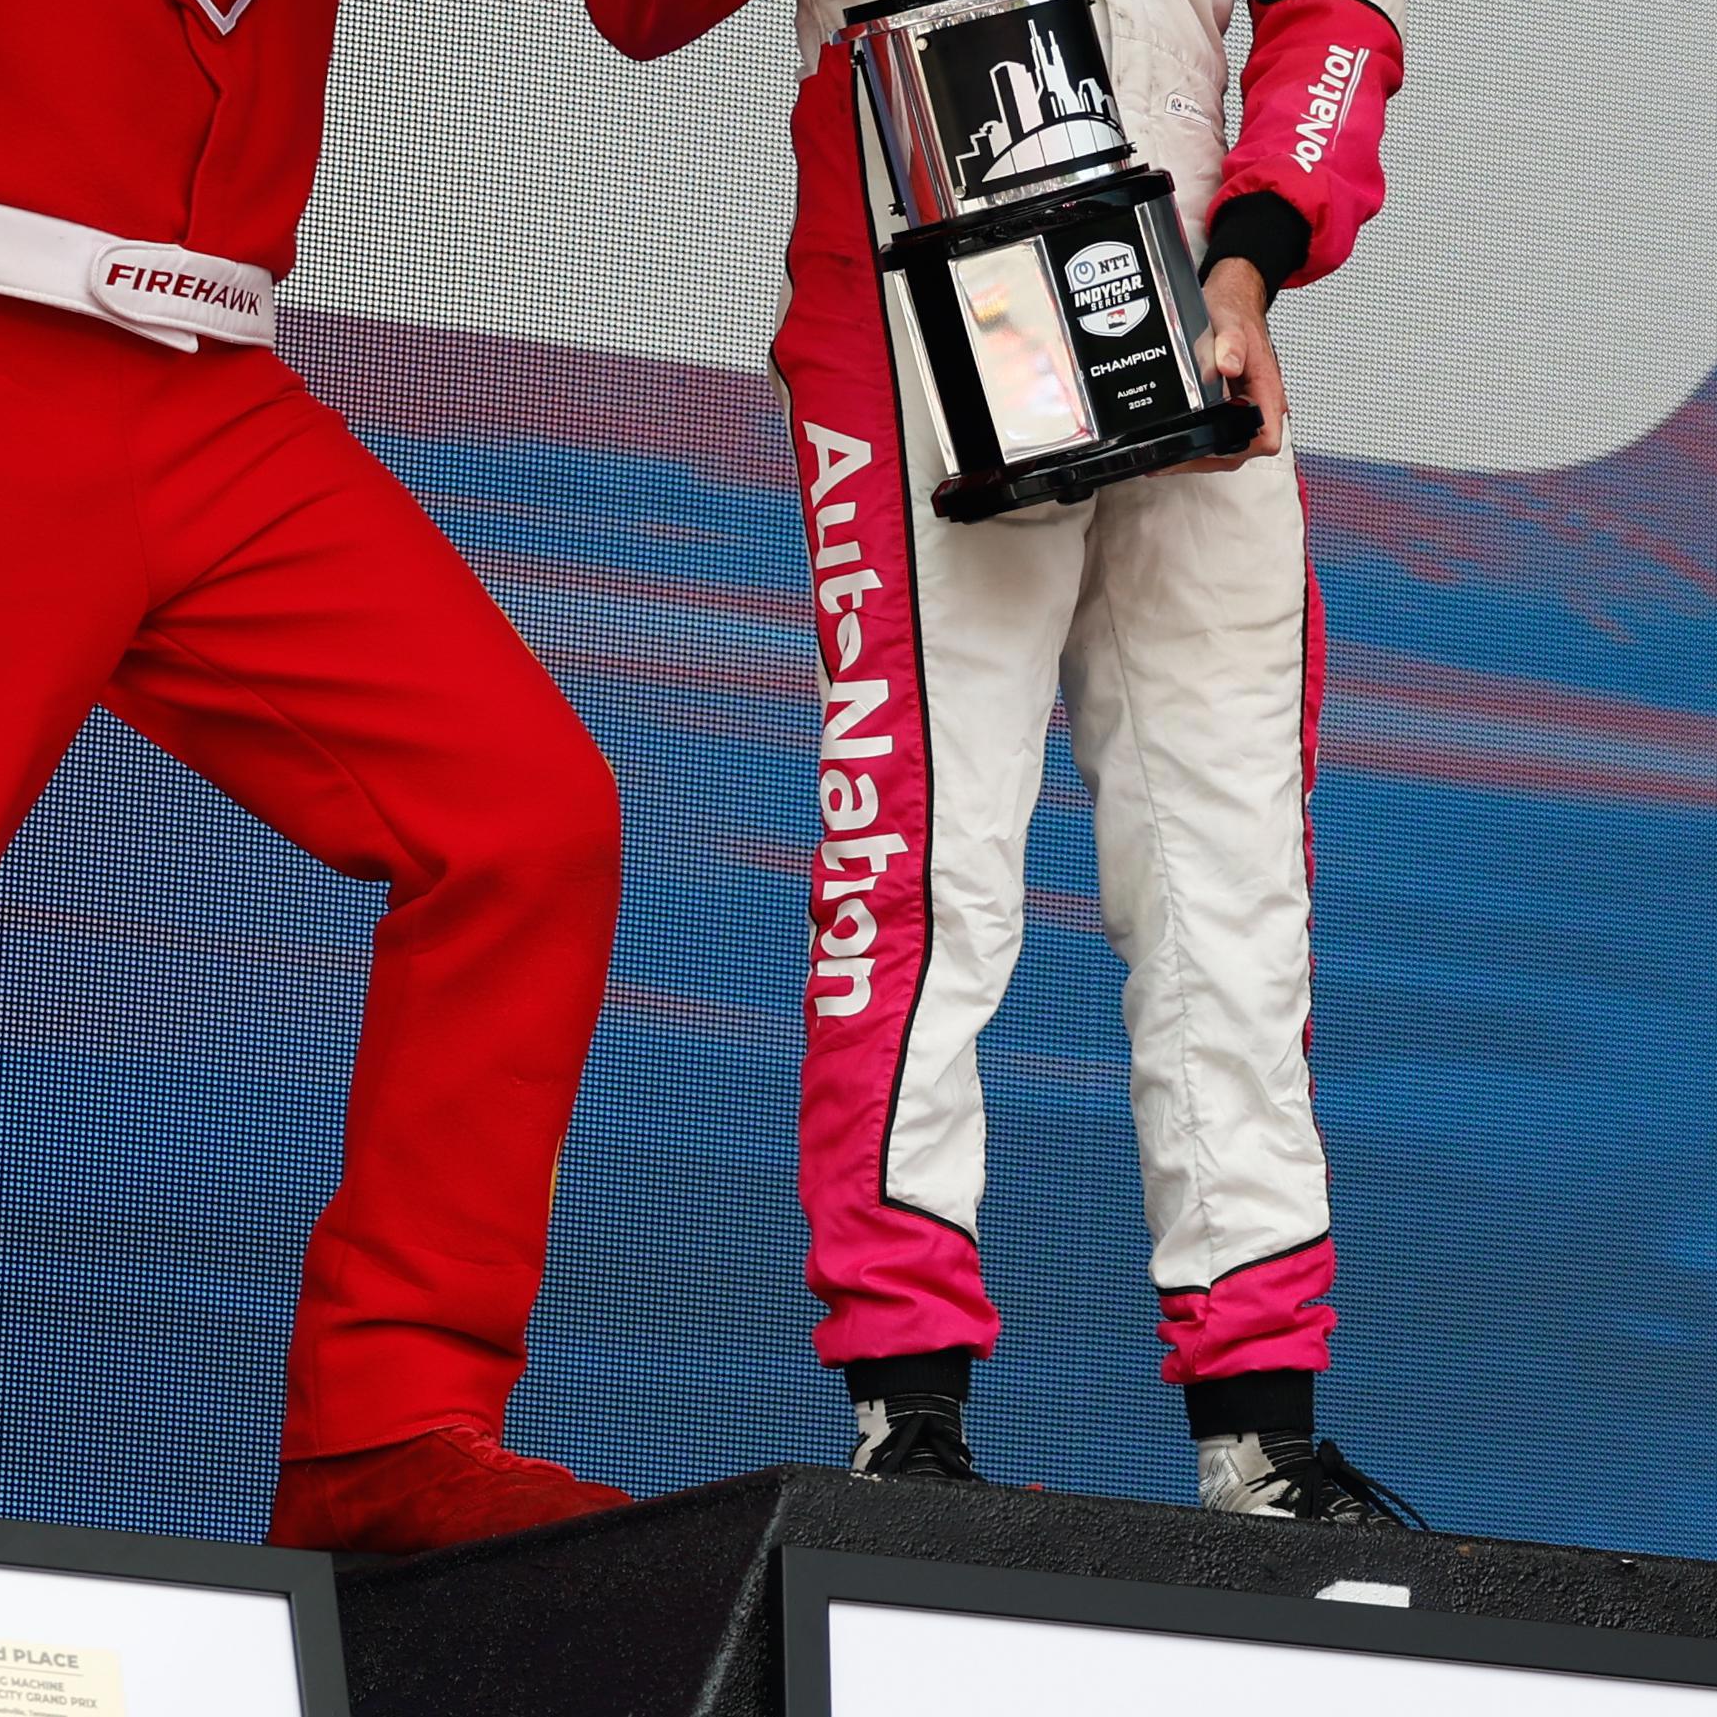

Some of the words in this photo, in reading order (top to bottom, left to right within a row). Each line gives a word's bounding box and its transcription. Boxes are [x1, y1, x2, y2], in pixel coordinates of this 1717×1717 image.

[1097, 253, 1131, 275] NTT
[104, 260, 263, 318] FIREHAWK
[1074, 273, 1145, 308] INDYCAR
[1090, 293, 1132, 312] SERIES
[1090, 344, 1168, 378] CHAMPION
[1127, 396, 1154, 411] 2023
[12, 1648, 80, 1670] PLACE
[11, 1676, 65, 1693] MACHINE
[26, 1692, 68, 1706] GRAND
[70, 1696, 98, 1709] PRIX
